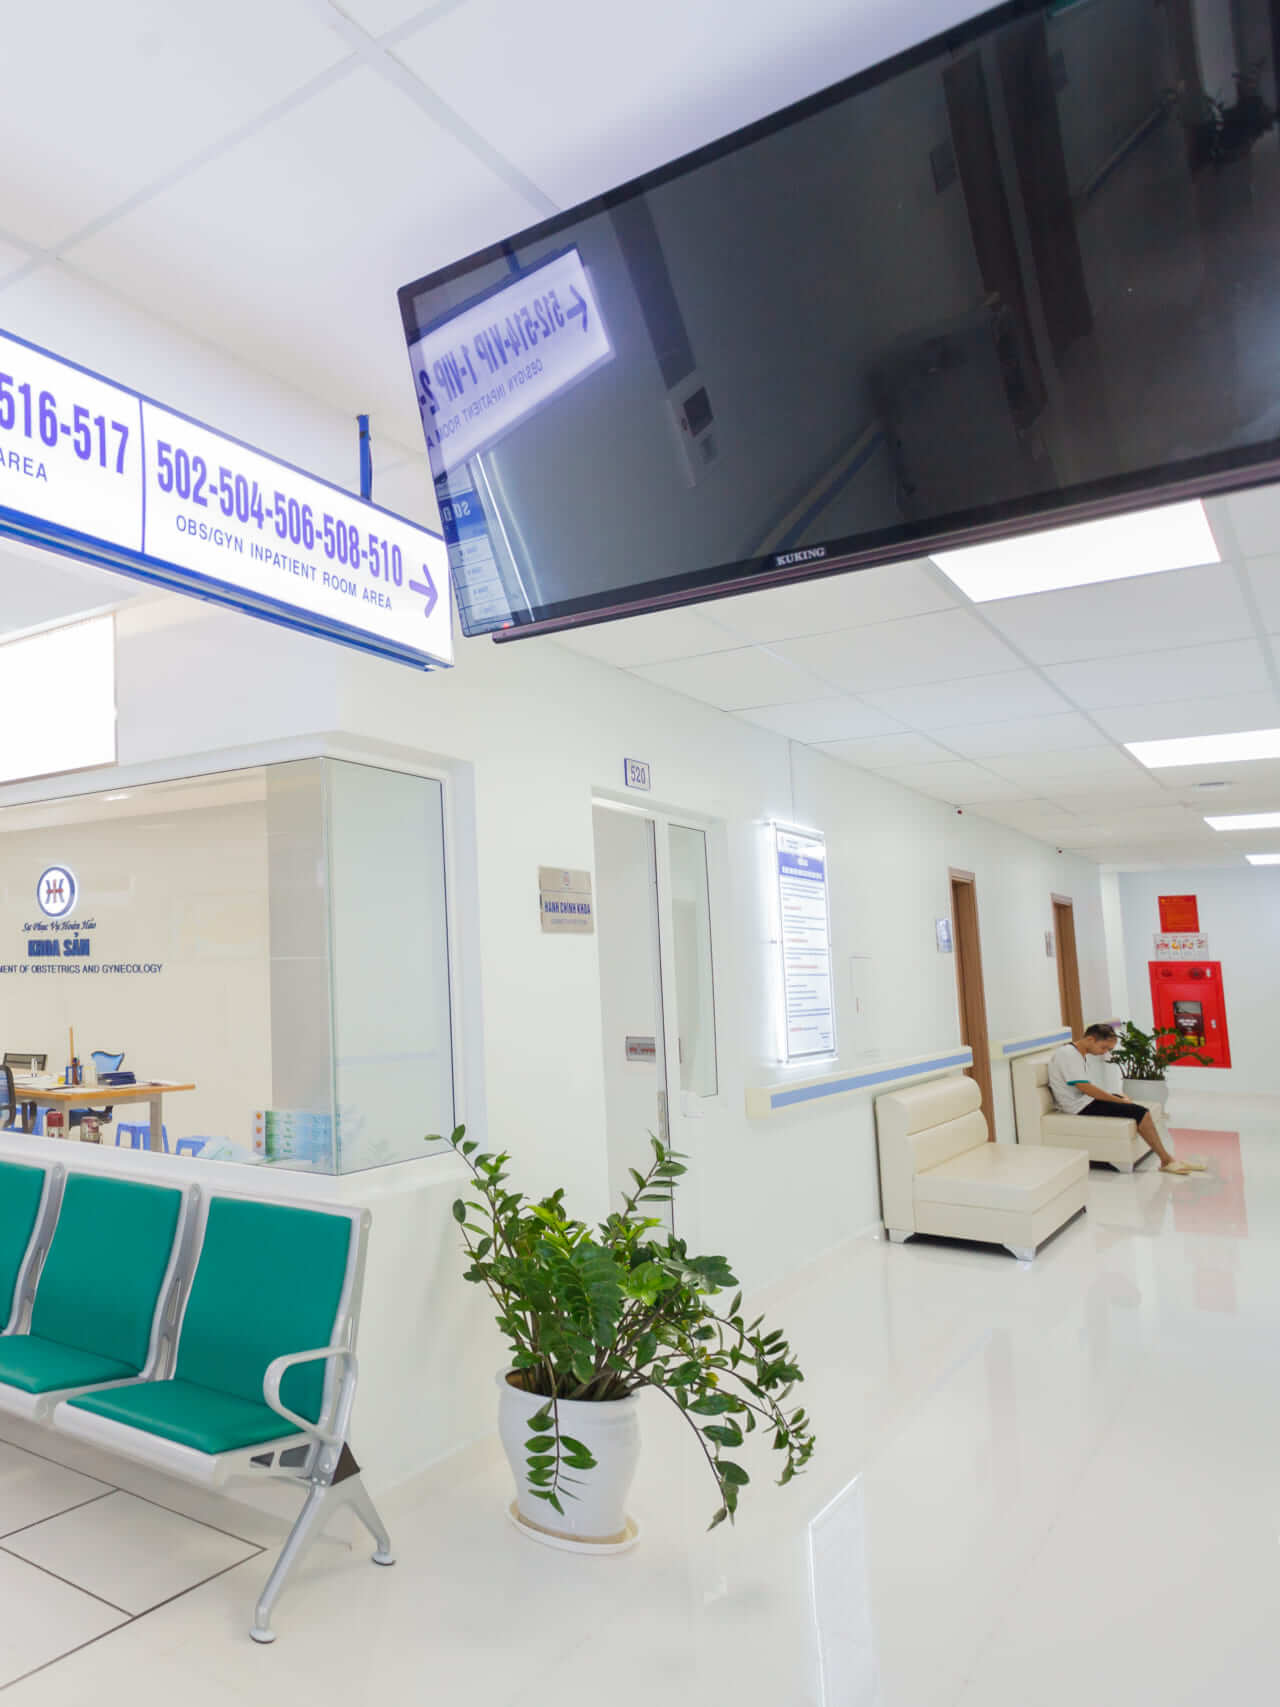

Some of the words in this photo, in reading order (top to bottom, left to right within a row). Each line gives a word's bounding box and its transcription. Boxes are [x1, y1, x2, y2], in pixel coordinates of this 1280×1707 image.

[157, 439, 403, 588] 502-504-506-508-510
[176, 514, 243, 553] OBS/GYN
[250, 542, 316, 582] INPATIENT
[322, 571, 357, 597] ROOM
[362, 587, 393, 611] AREA
[776, 547, 825, 566] KUKING
[630, 765, 646, 785] 520
[19, 964, 30, 974] OF
[31, 964, 81, 974] OBSTETRICS
[82, 964, 100, 974] AND
[102, 963, 163, 974] GYNECOLOGY
